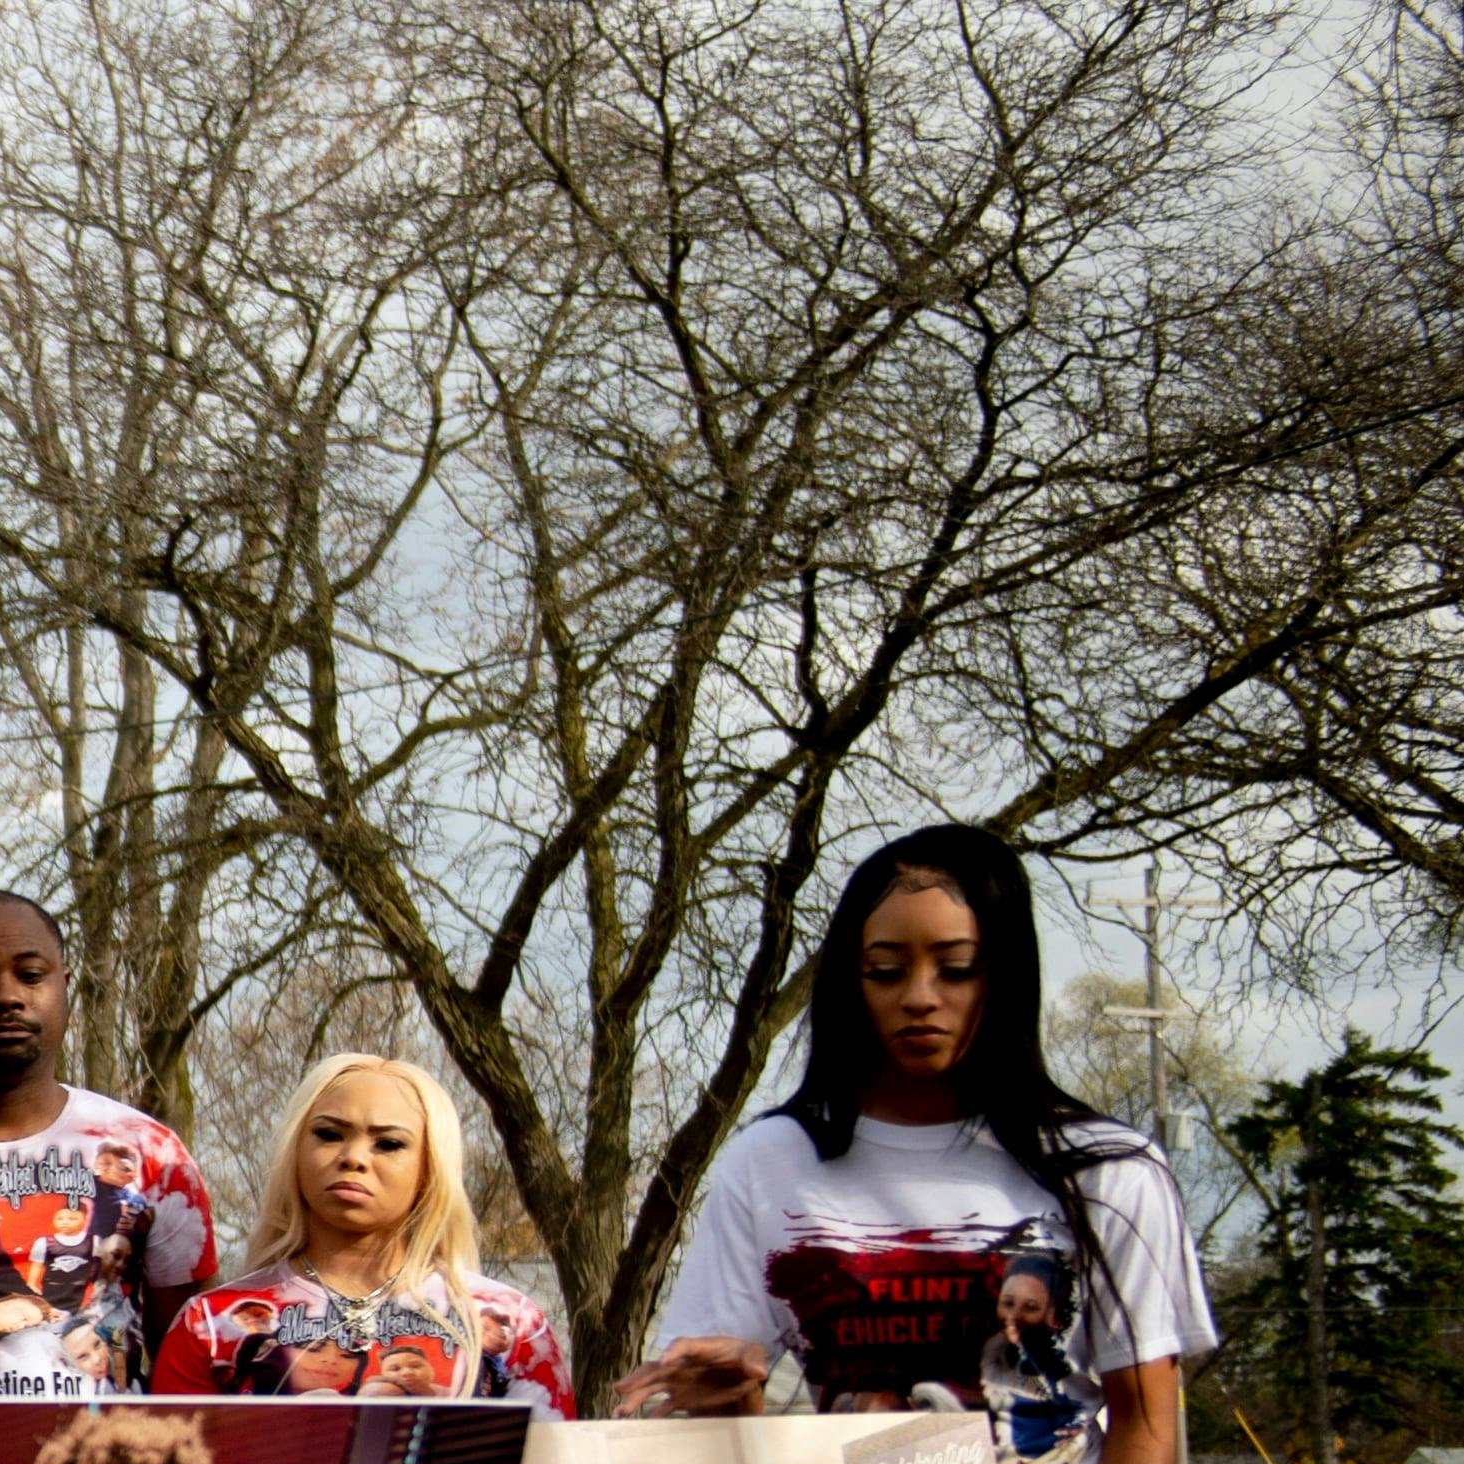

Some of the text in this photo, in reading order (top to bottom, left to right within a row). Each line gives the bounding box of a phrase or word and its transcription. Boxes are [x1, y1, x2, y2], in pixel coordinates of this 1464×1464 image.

[868, 1278, 974, 1303] FLINT
[833, 1312, 945, 1345] EHICLE
[52, 1371, 82, 1396] For
